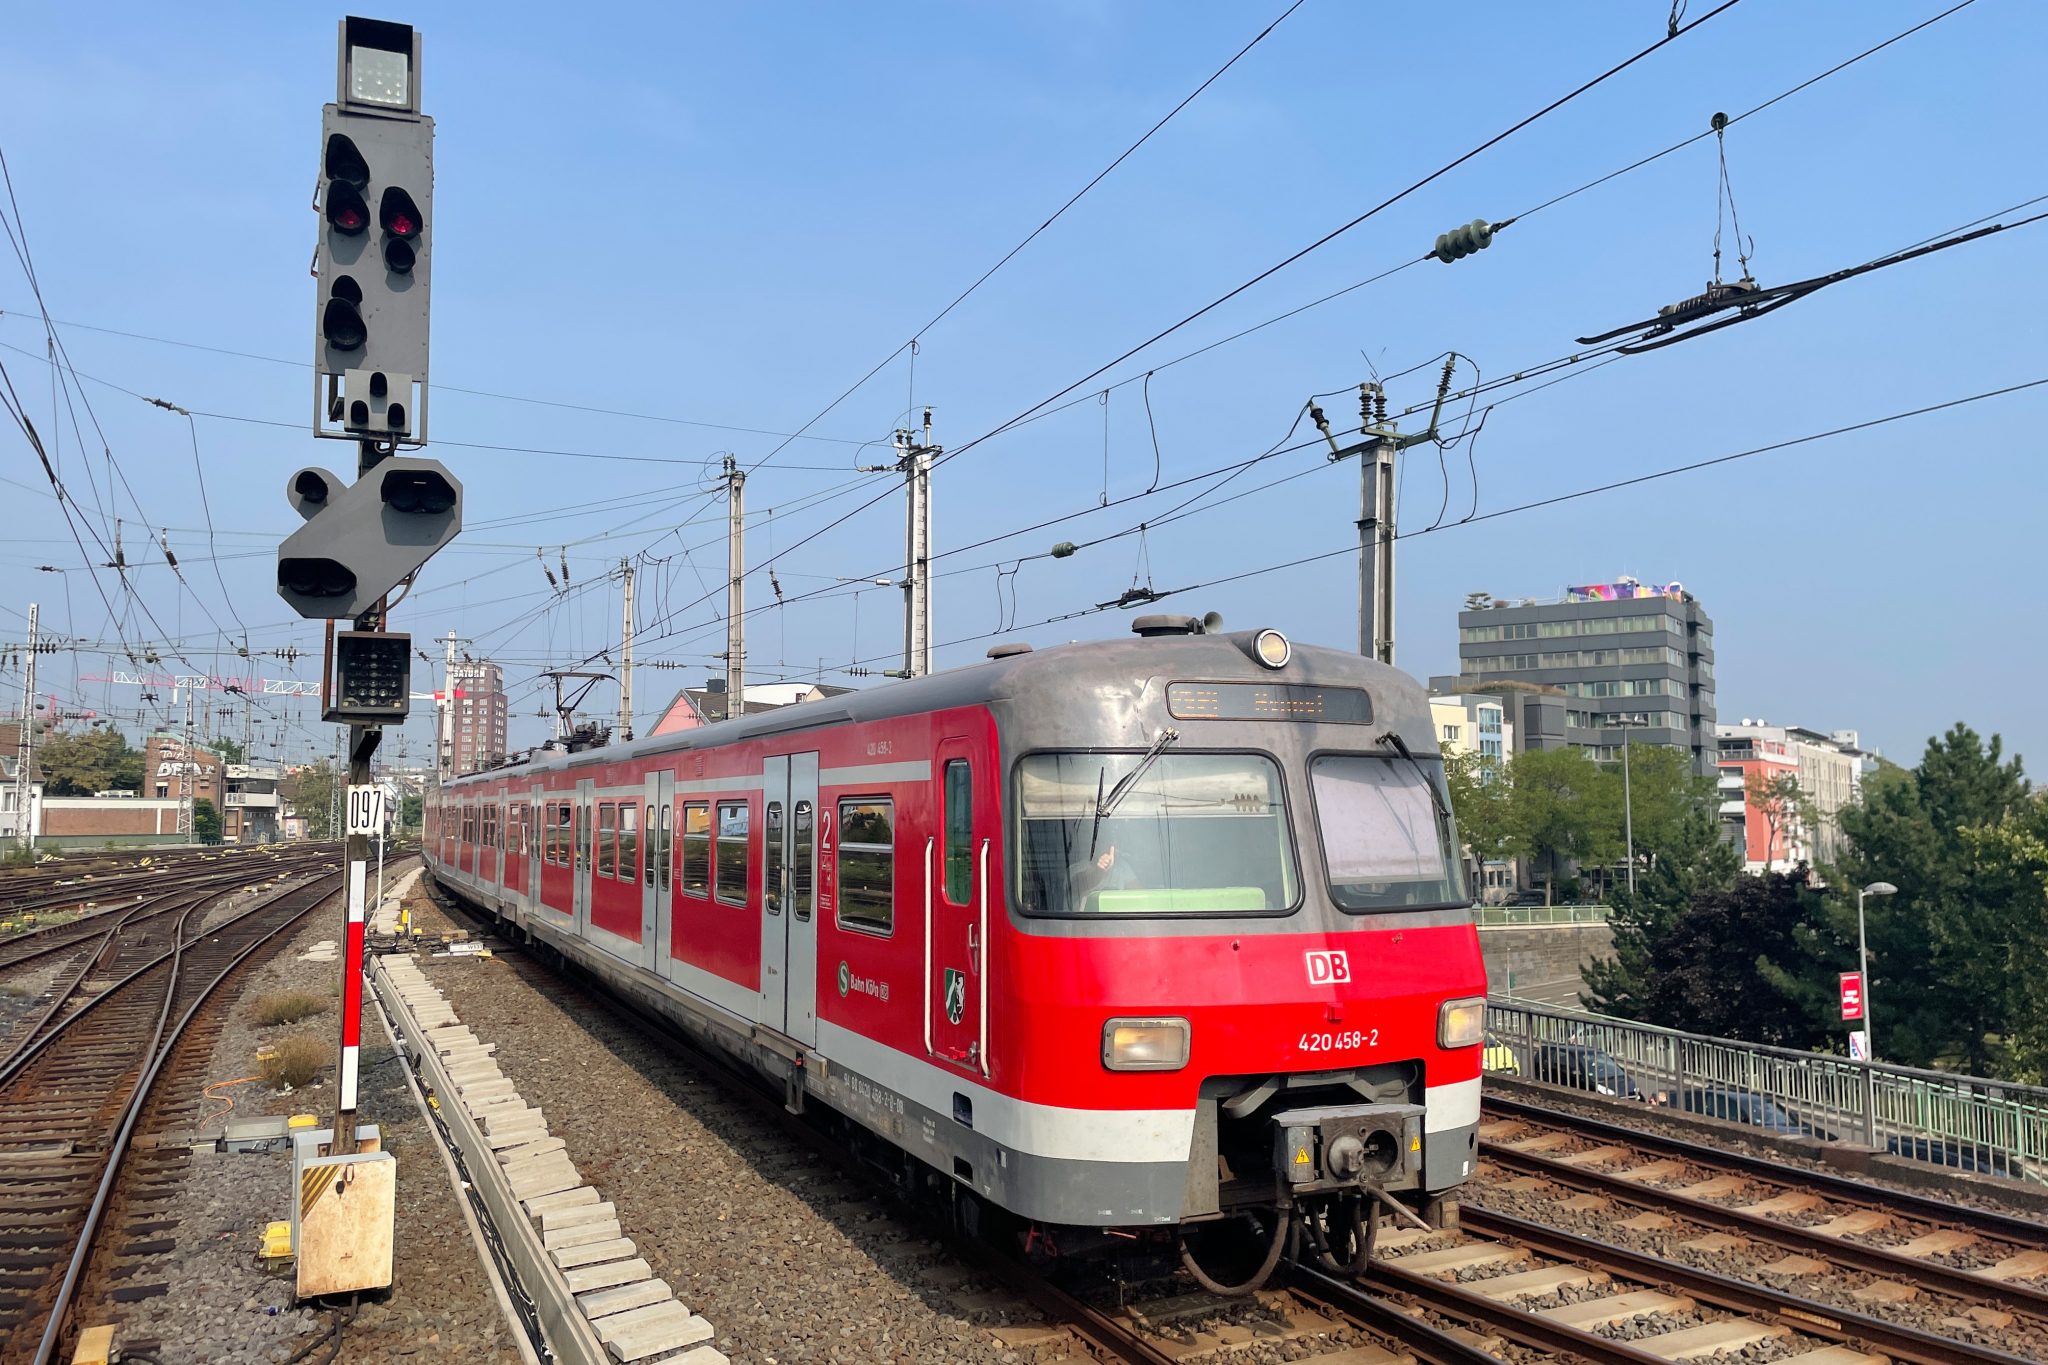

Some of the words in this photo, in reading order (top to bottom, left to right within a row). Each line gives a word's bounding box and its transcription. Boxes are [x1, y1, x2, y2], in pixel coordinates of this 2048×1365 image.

[350, 790, 381, 829] 097
[822, 810, 831, 849] 2
[1308, 952, 1349, 982] DB
[850, 973, 865, 993] Bahn
[865, 978, 879, 998] Köln
[1298, 1033, 1332, 1051] 420
[1334, 1029, 1379, 1050] 458-2
